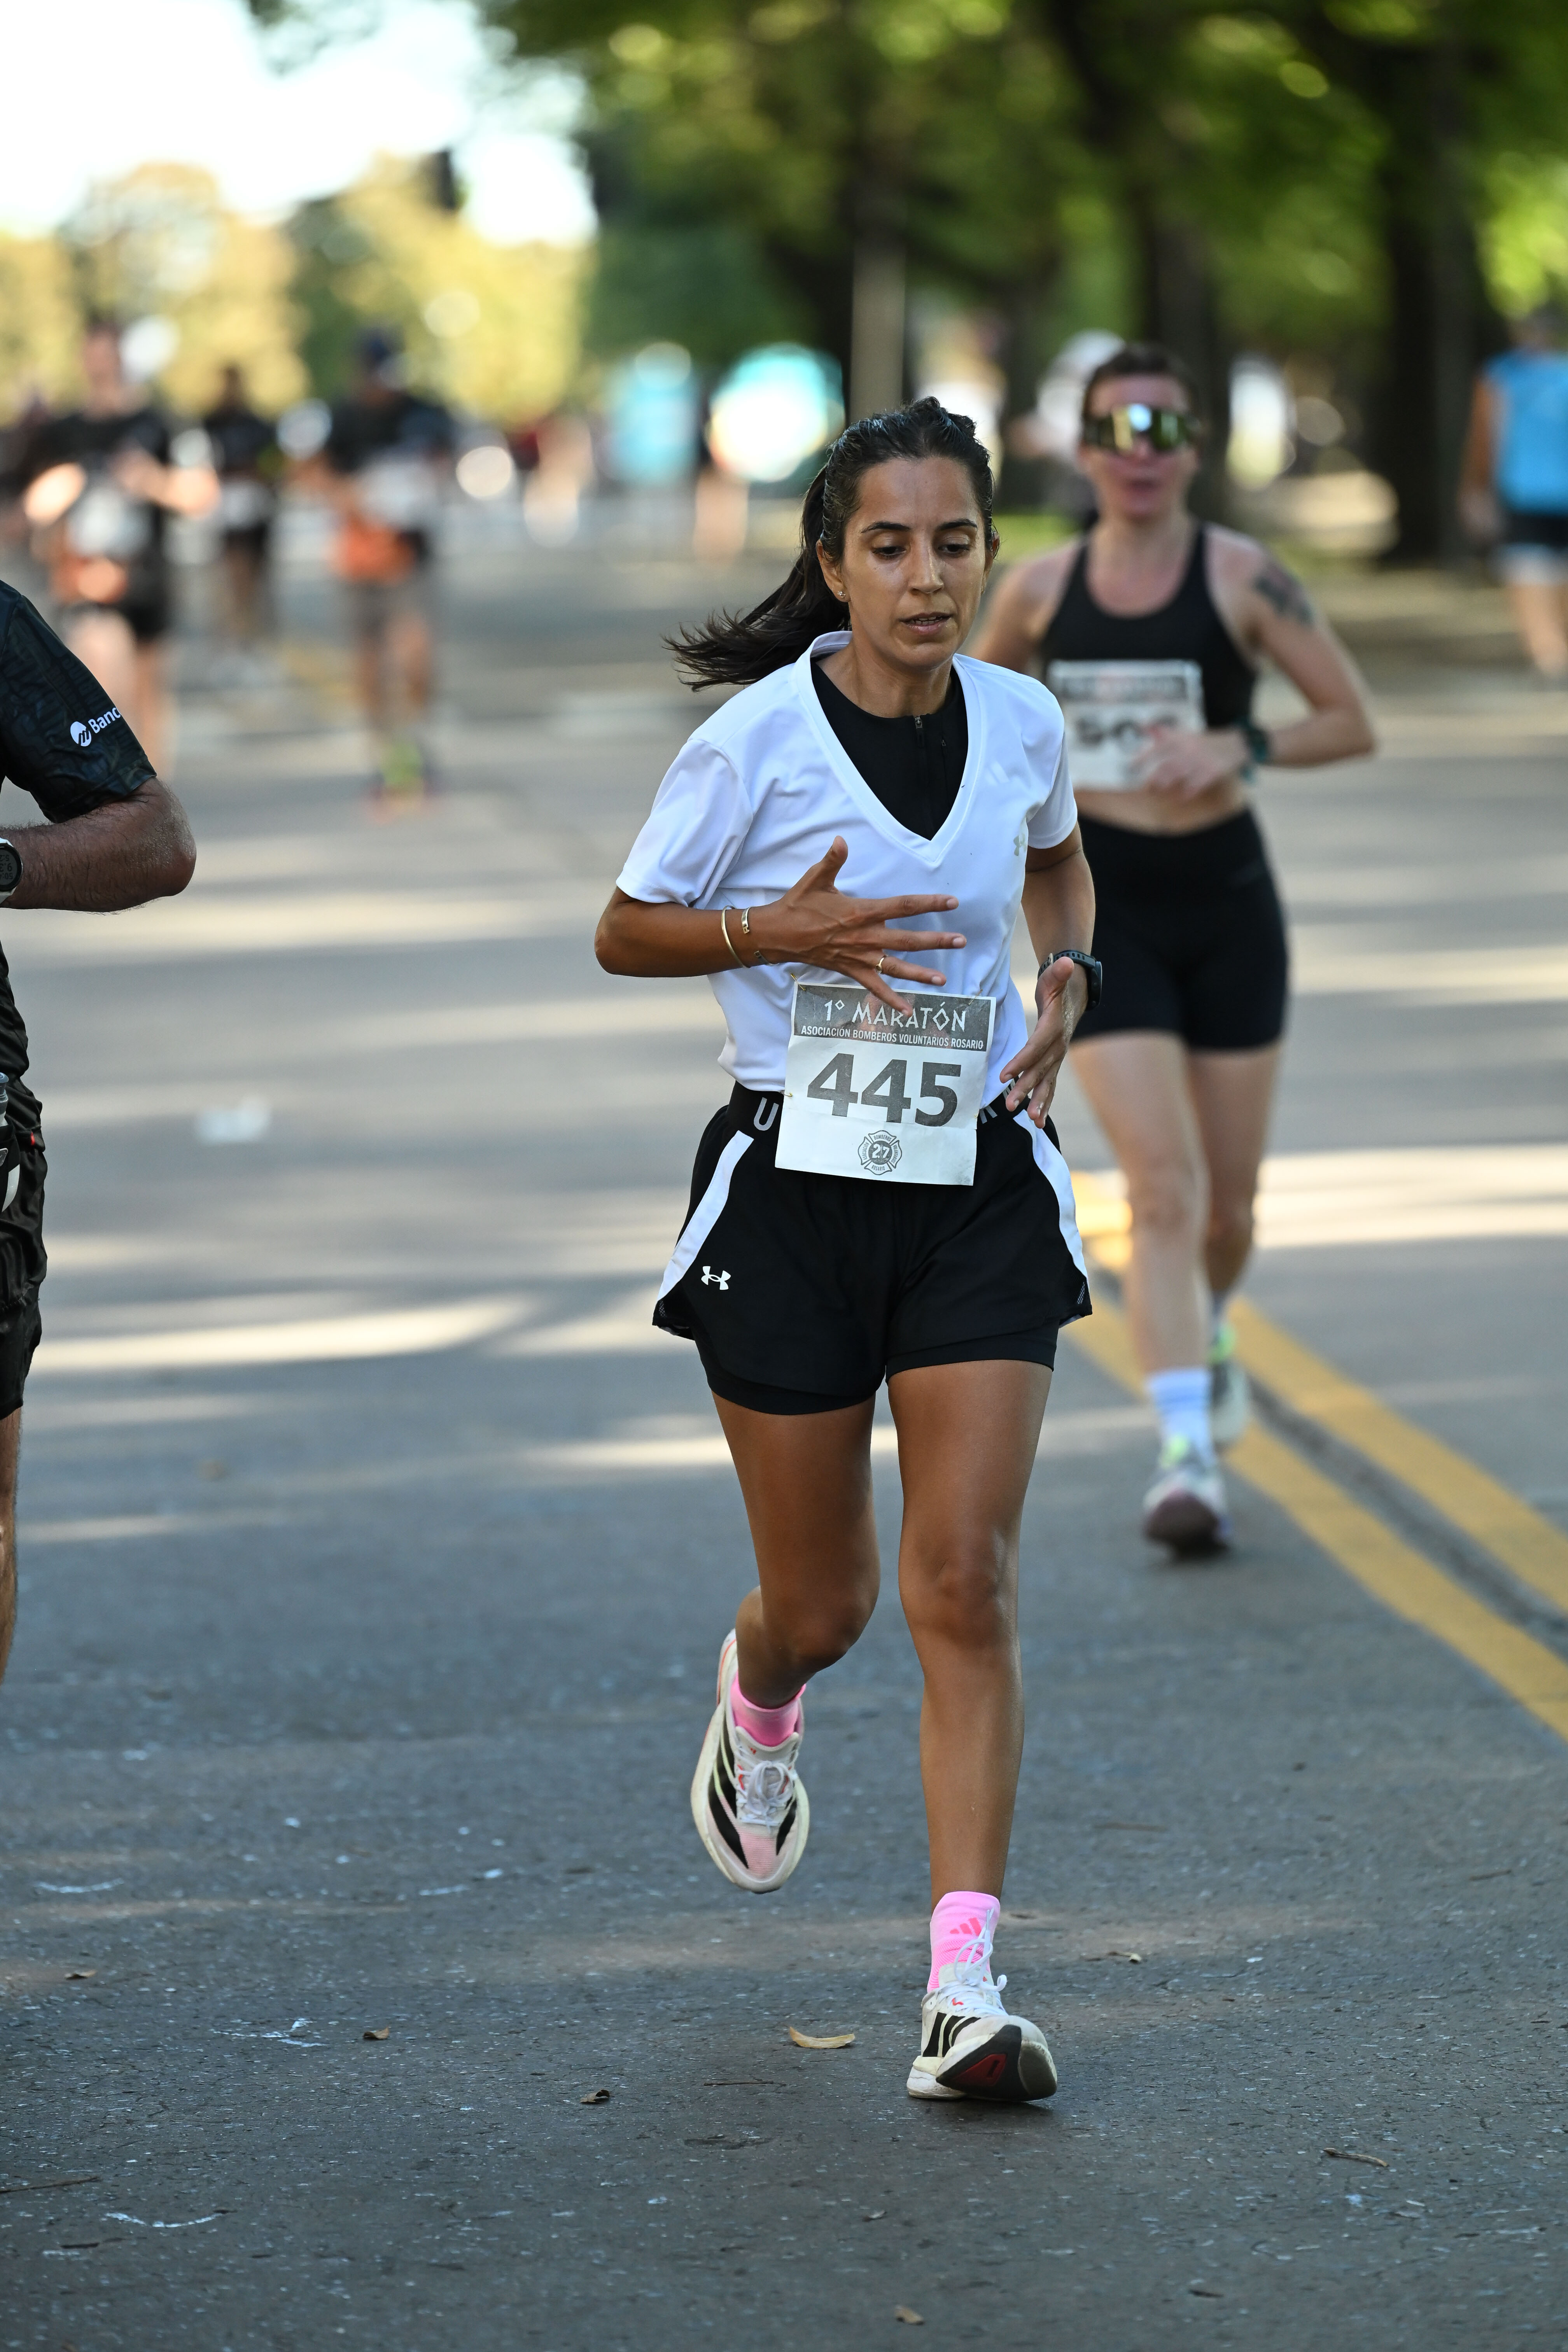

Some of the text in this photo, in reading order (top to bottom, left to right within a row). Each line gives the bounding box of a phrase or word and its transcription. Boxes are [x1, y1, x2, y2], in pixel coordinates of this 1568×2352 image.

[851, 1001, 966, 1032] MARATÓN
[801, 1025, 984, 1050] ASOCIACIÓN BOMBEROS VOLUNTARIOS ROSARIO
[807, 1053, 961, 1127] 445
[872, 1143, 890, 1158] 27
